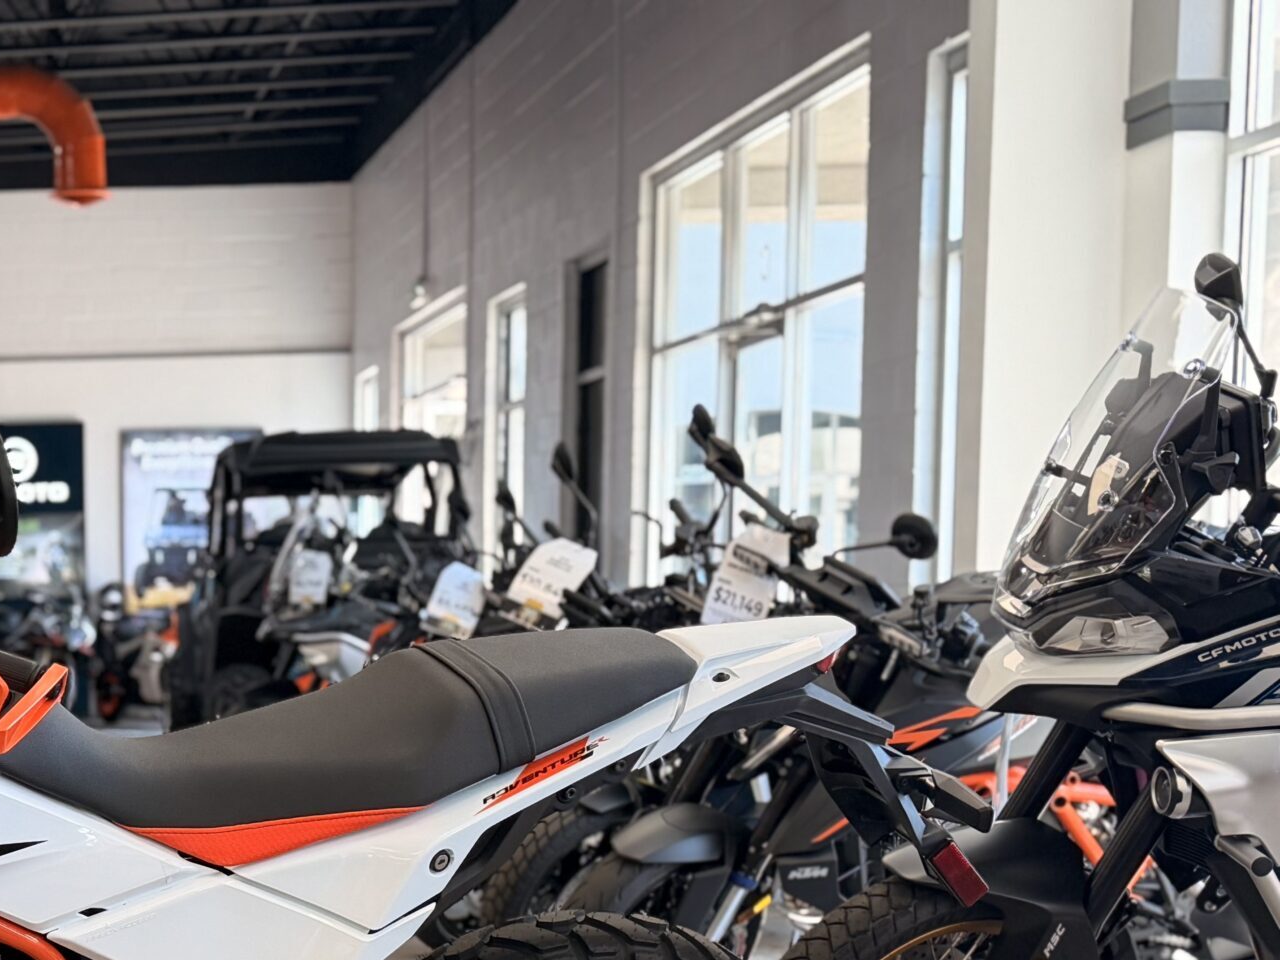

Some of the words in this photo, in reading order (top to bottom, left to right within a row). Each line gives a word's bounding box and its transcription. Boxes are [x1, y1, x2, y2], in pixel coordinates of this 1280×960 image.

[1197, 628, 1280, 662] CFMOTO
[483, 743, 599, 804] ADVENTURE
[1043, 922, 1066, 958] MSC
